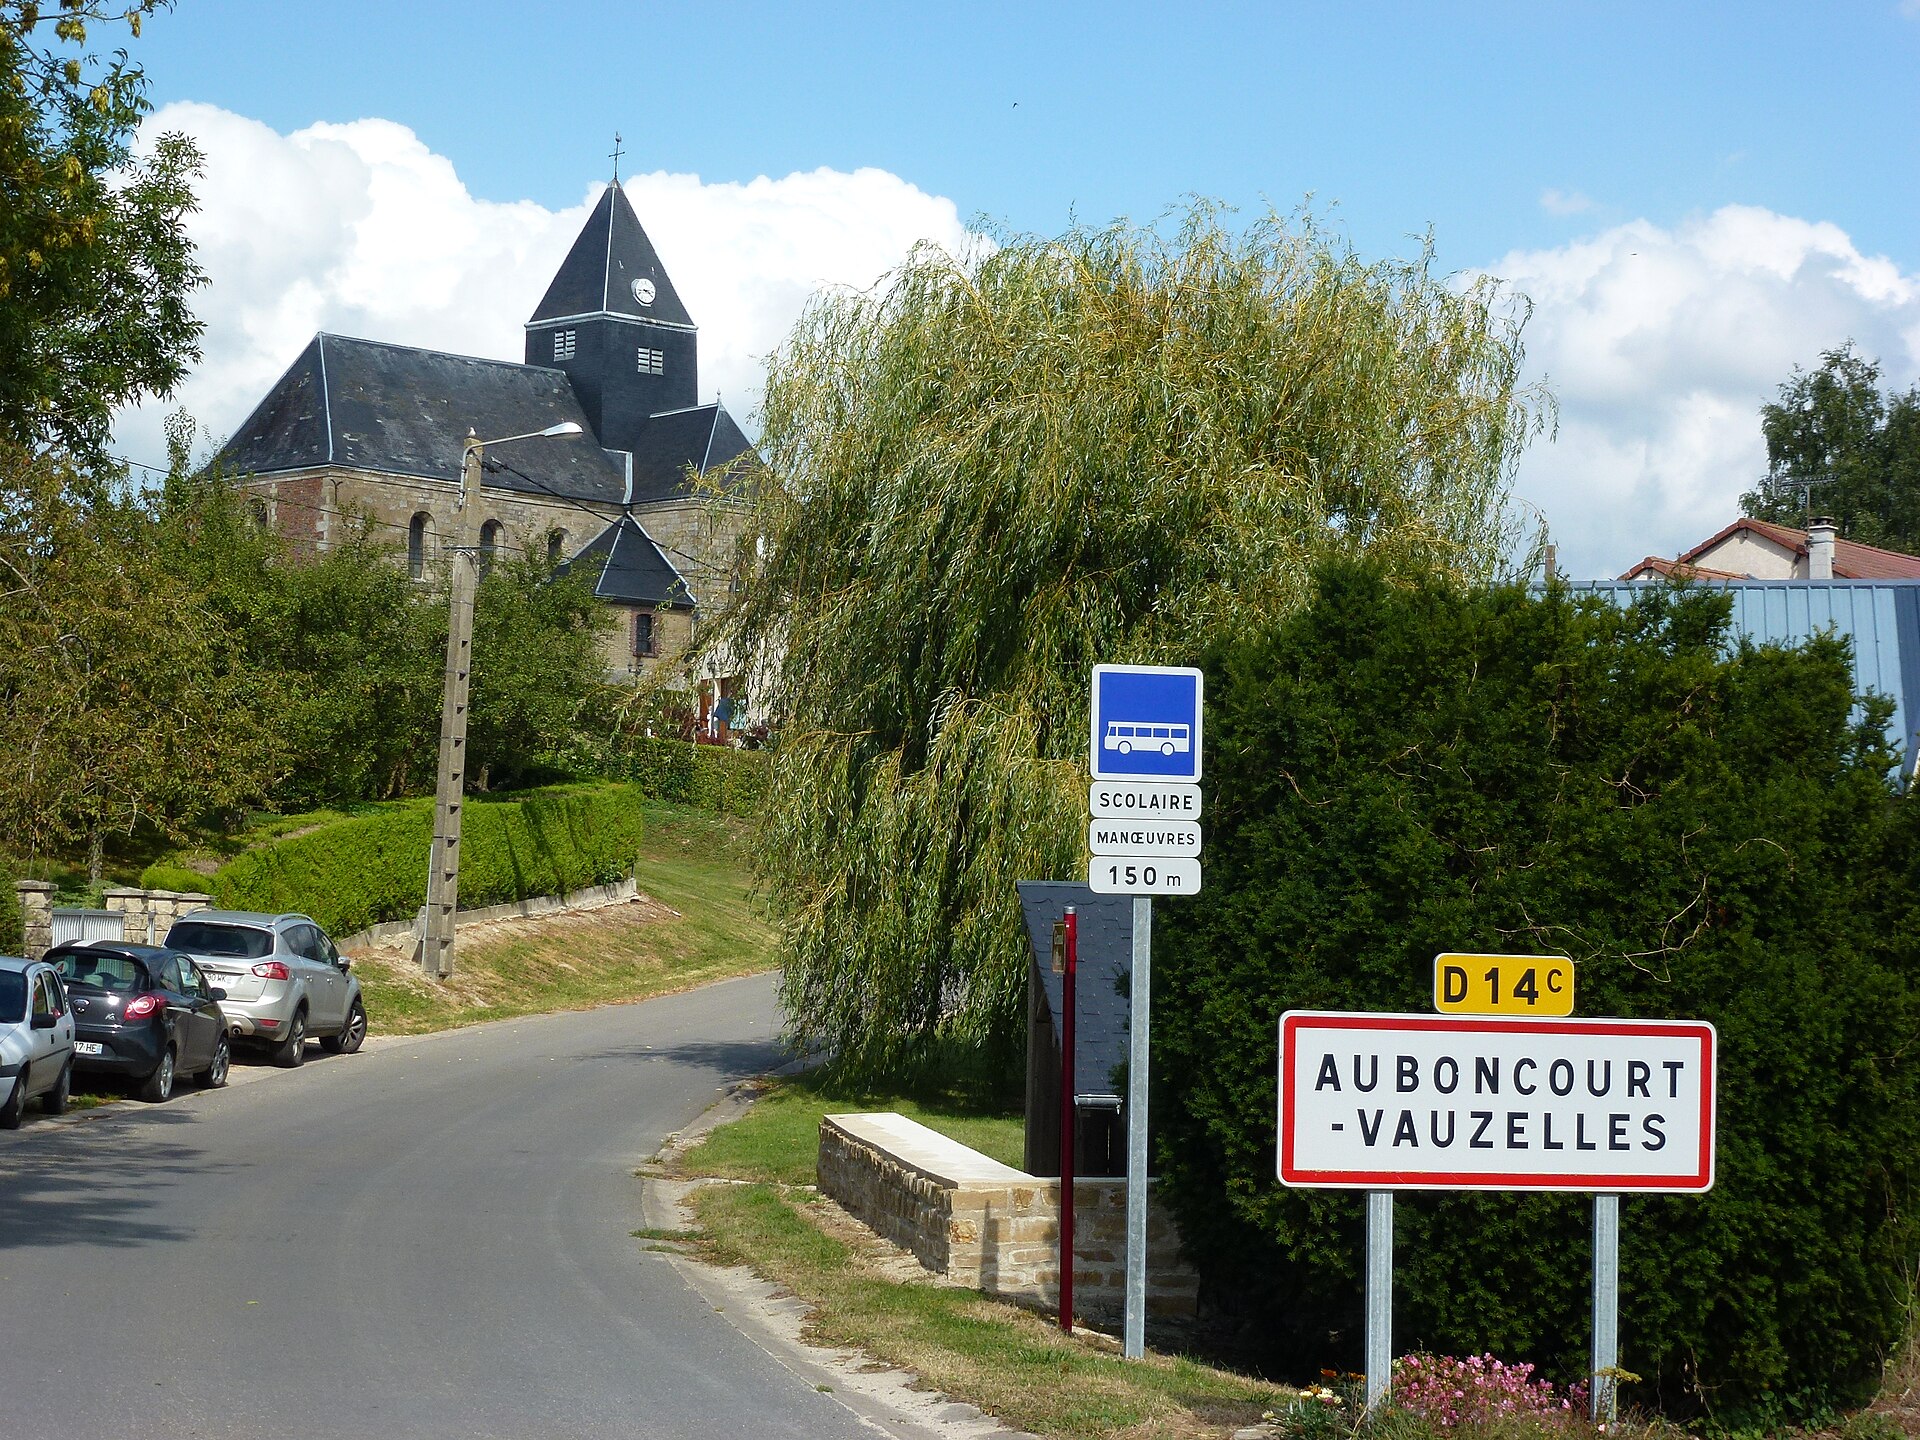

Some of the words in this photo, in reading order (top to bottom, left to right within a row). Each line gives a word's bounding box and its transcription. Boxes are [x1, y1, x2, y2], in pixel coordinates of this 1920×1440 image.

[1099, 792, 1193, 810] SCOLAIRE
[1097, 831, 1195, 846] MANŒUVRES
[1109, 865, 1157, 886] 150
[1166, 875, 1181, 887] m
[1443, 965, 1468, 1003] D
[1314, 1053, 1684, 1098] AUBONCOURT
[1331, 1108, 1666, 1152] -VAUZELLES
